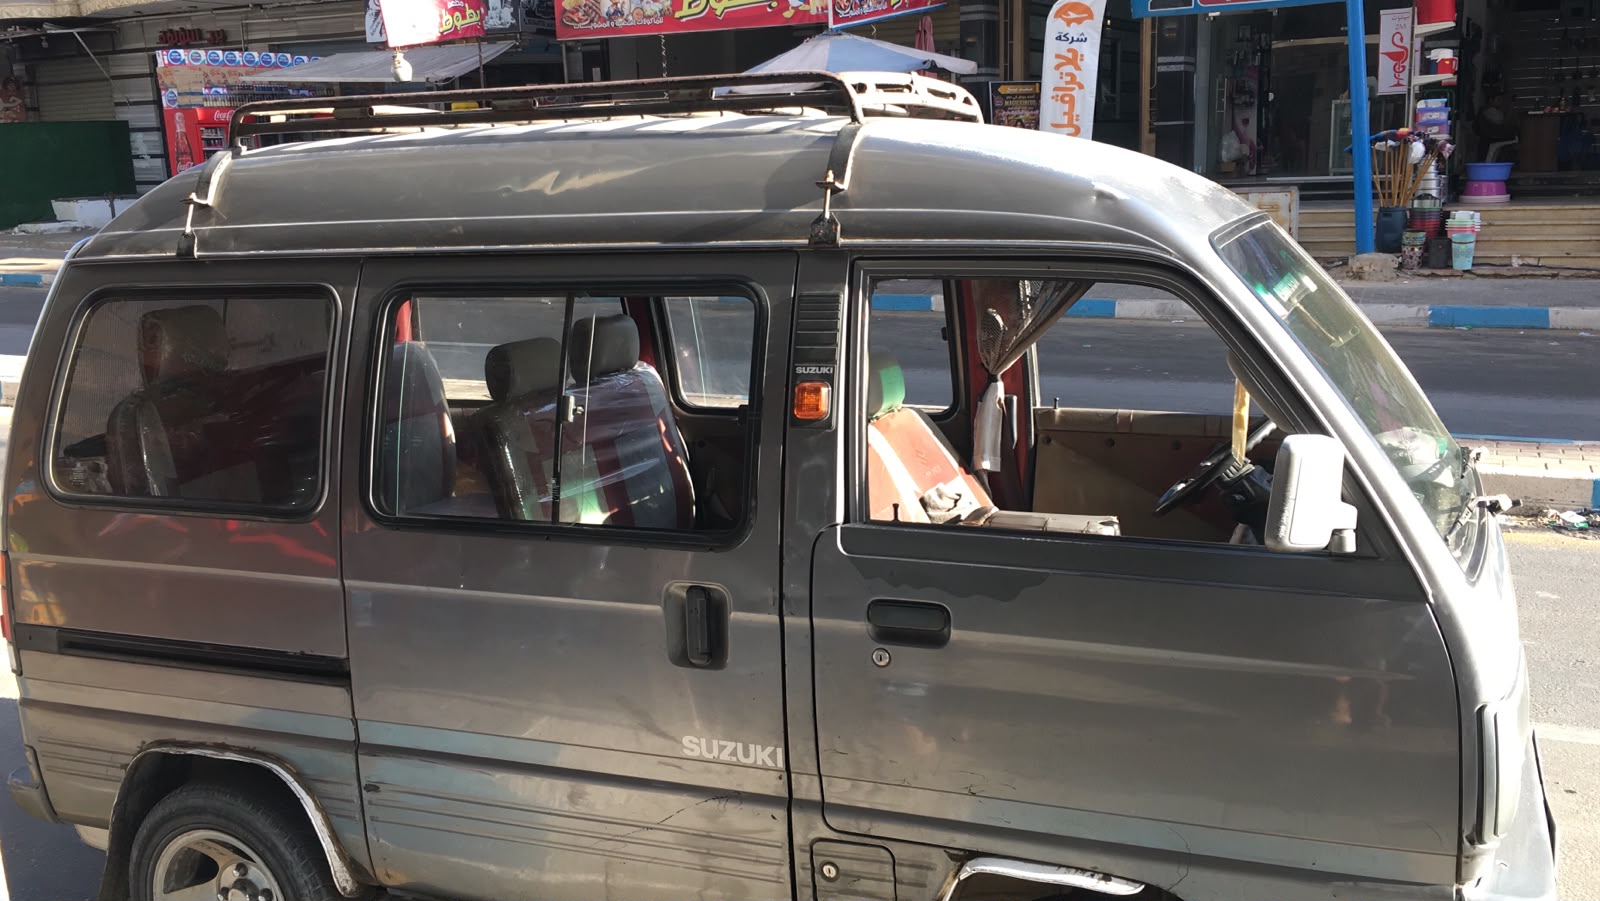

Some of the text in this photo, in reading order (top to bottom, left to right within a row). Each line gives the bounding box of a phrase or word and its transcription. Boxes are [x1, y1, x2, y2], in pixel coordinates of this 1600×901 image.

[439, 3, 481, 33] بطوط
[1055, 31, 1088, 45] شركة
[795, 366, 833, 374] SUZUKI
[681, 734, 784, 769] SUZUKI
